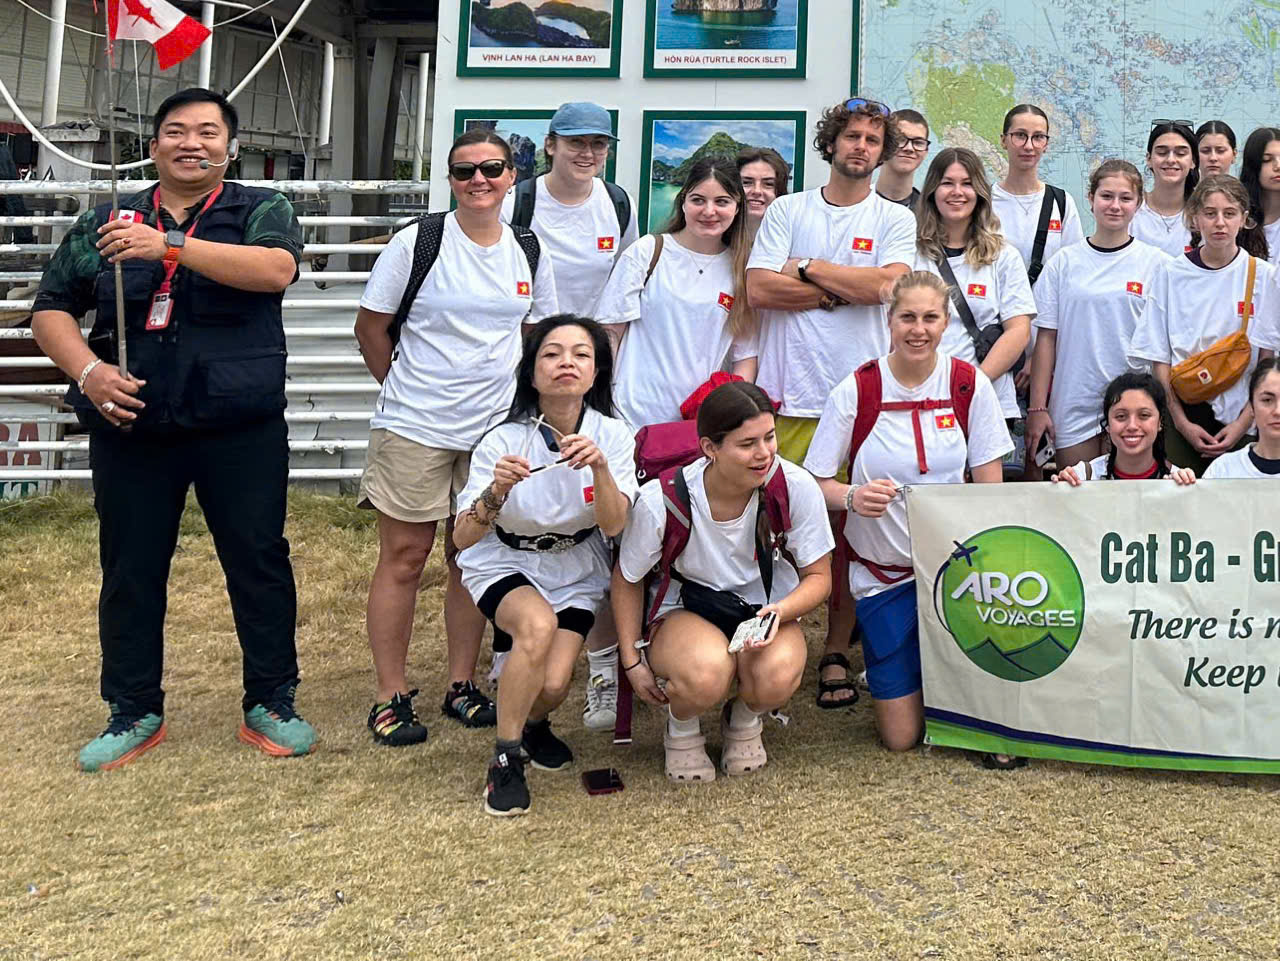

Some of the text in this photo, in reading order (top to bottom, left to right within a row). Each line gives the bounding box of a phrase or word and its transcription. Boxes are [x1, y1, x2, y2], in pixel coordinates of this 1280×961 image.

[505, 54, 523, 62] LAN
[539, 54, 559, 63] (LAN
[576, 55, 596, 63] BAY)
[702, 55, 736, 65] (TURTLE
[762, 56, 787, 65] ISLET)
[1100, 531, 1158, 584] Cat
[1170, 531, 1215, 583] Ba
[1227, 555, 1241, 566] -
[951, 571, 1049, 608] ARO
[976, 605, 1078, 628] VOYAGES
[1128, 608, 1218, 640] There
[1228, 608, 1255, 639] is
[1184, 656, 1266, 694] Keep
